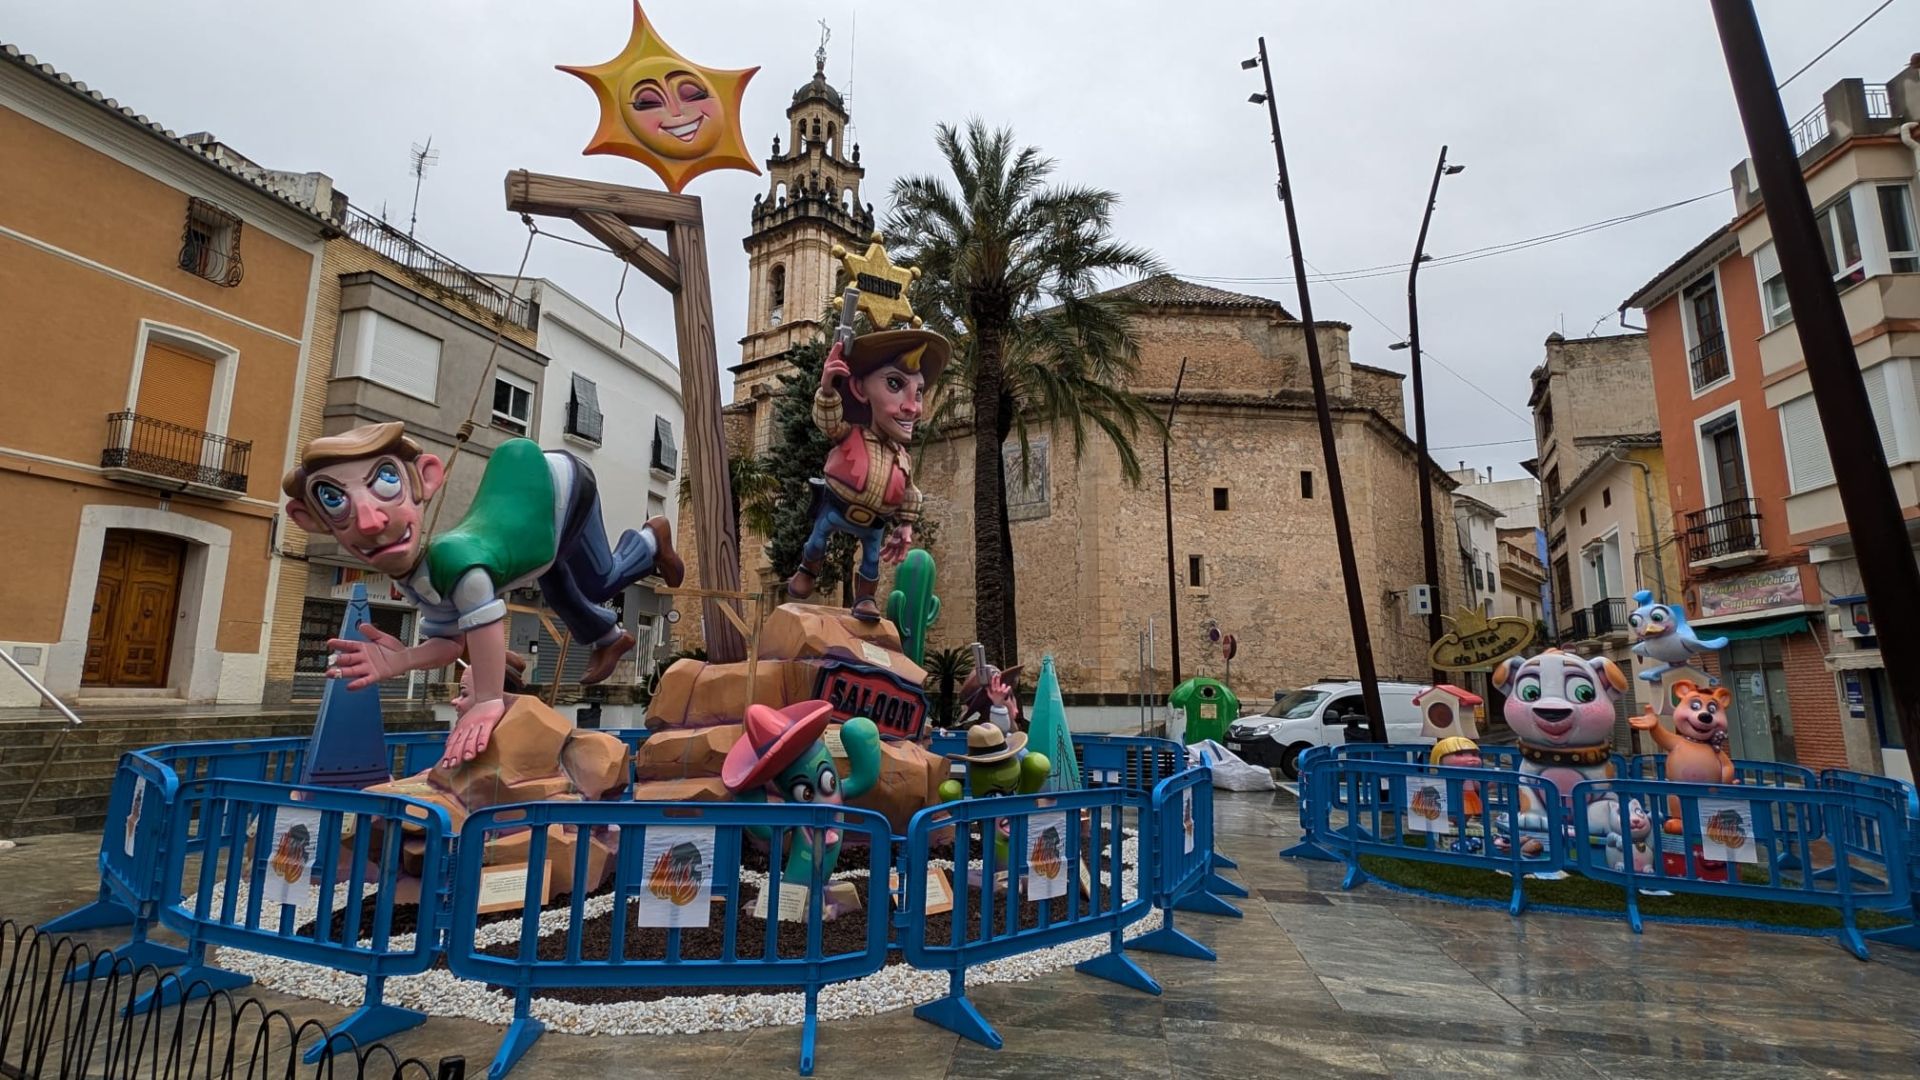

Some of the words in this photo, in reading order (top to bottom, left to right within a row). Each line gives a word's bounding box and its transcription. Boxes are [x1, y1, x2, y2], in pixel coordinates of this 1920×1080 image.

[1454, 654, 1472, 664] de
[1475, 651, 1489, 663] la
[1491, 637, 1518, 656] casa
[1463, 640, 1475, 651] El
[830, 677, 917, 731] SALOON
